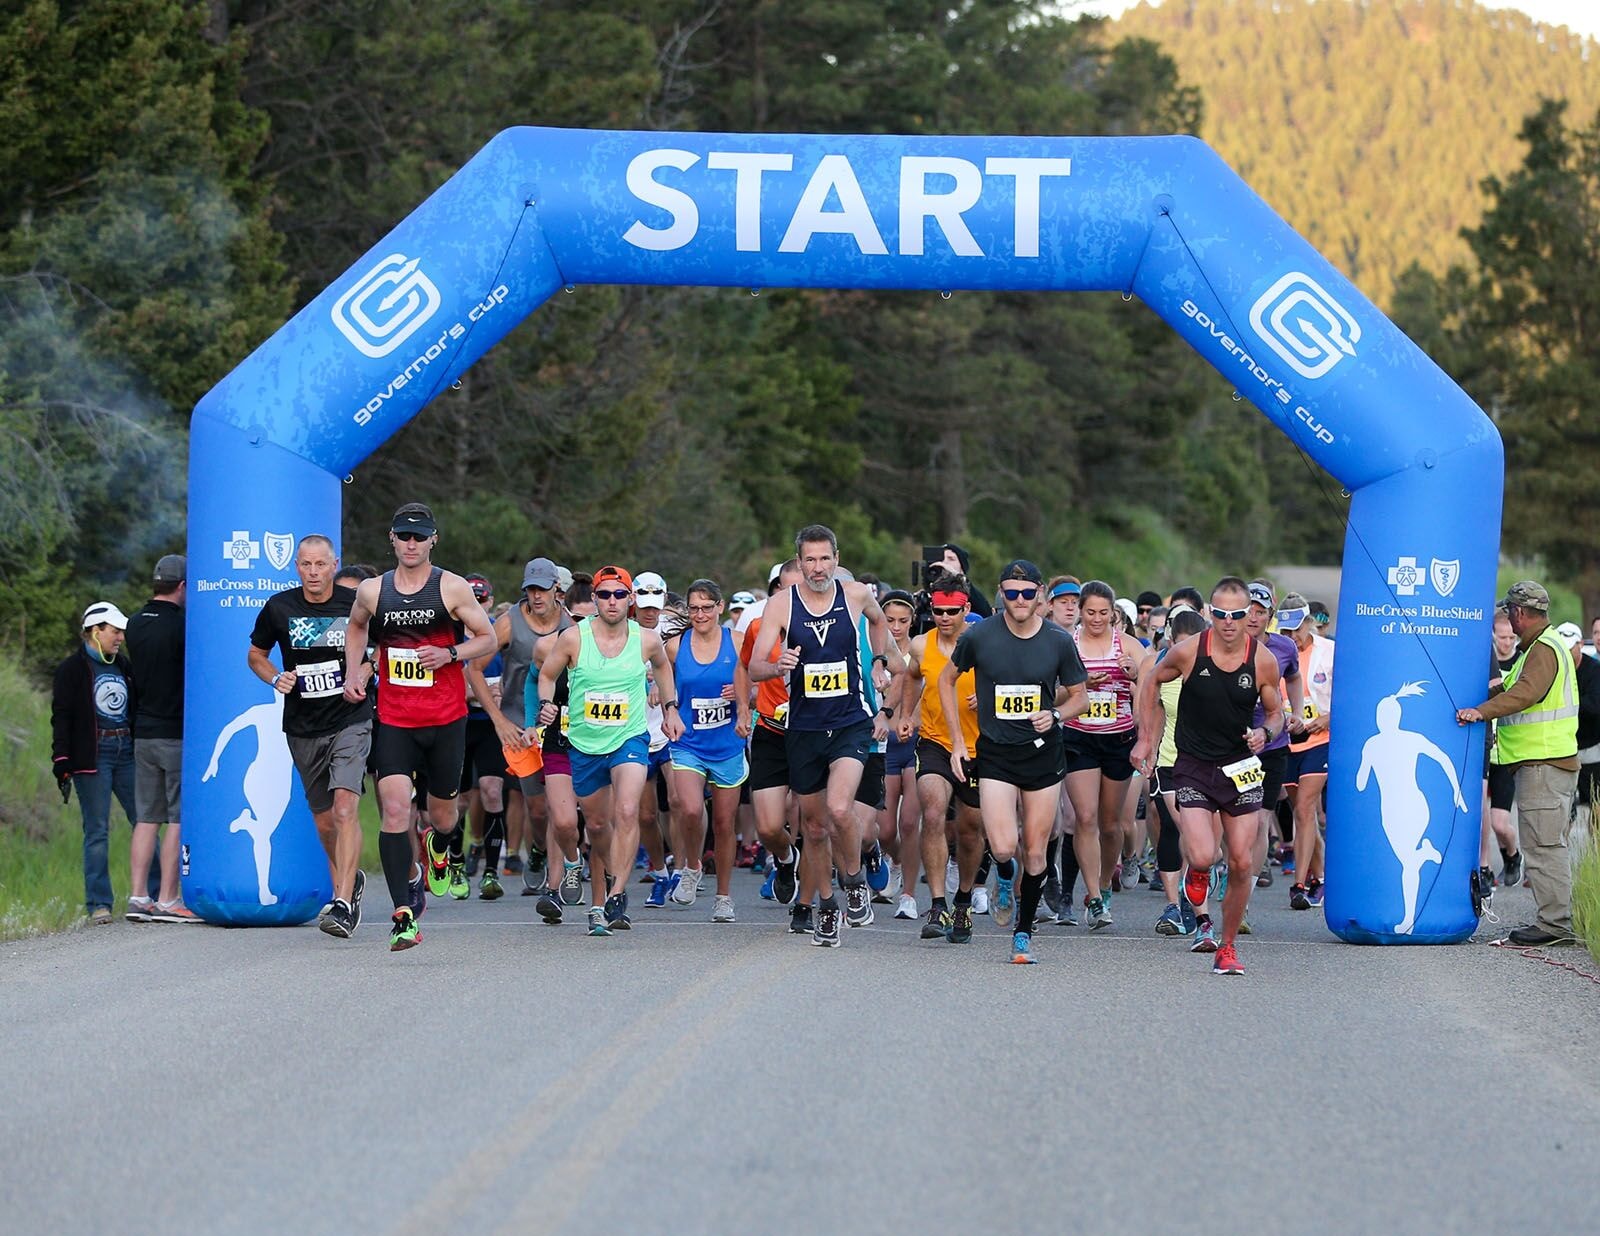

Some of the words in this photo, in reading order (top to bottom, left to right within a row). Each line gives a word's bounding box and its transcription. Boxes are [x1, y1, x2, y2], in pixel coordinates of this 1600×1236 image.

[622, 148, 1071, 258] START
[353, 323, 466, 427] governor's
[468, 284, 511, 322] cup
[1180, 299, 1292, 405] governor's
[1295, 406, 1335, 445] cup
[197, 578, 255, 592] BlueCross
[220, 595, 235, 608] of
[390, 610, 410, 620] DICK
[411, 609, 435, 619] POND
[1356, 603, 1418, 617] BlueCross
[1421, 605, 1483, 621] BlueShield
[1381, 621, 1397, 634] of
[1400, 622, 1459, 636] Montana
[394, 661, 426, 680] 408
[304, 672, 336, 692] 806
[811, 673, 841, 692] 421
[590, 703, 622, 720] 444
[1002, 696, 1034, 713] 485
[698, 707, 726, 724] 820
